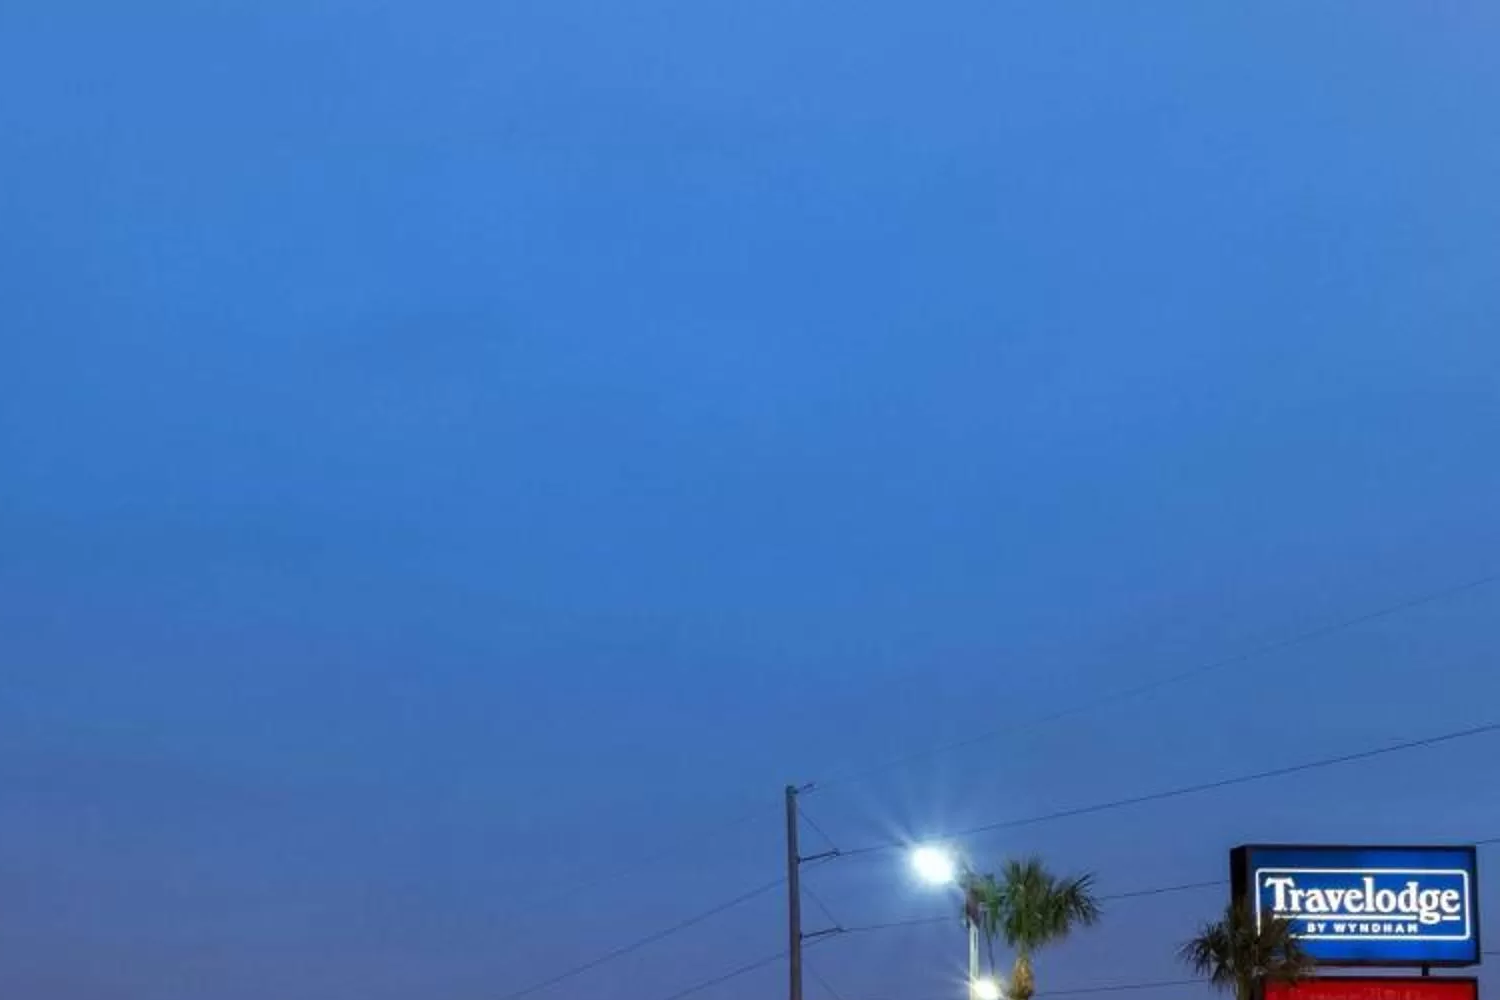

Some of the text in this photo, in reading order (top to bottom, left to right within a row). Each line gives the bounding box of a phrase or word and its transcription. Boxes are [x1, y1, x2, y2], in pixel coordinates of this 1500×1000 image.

[1264, 876, 1461, 924] Travelodge
[1307, 922, 1419, 934] BY WYNDHAM
